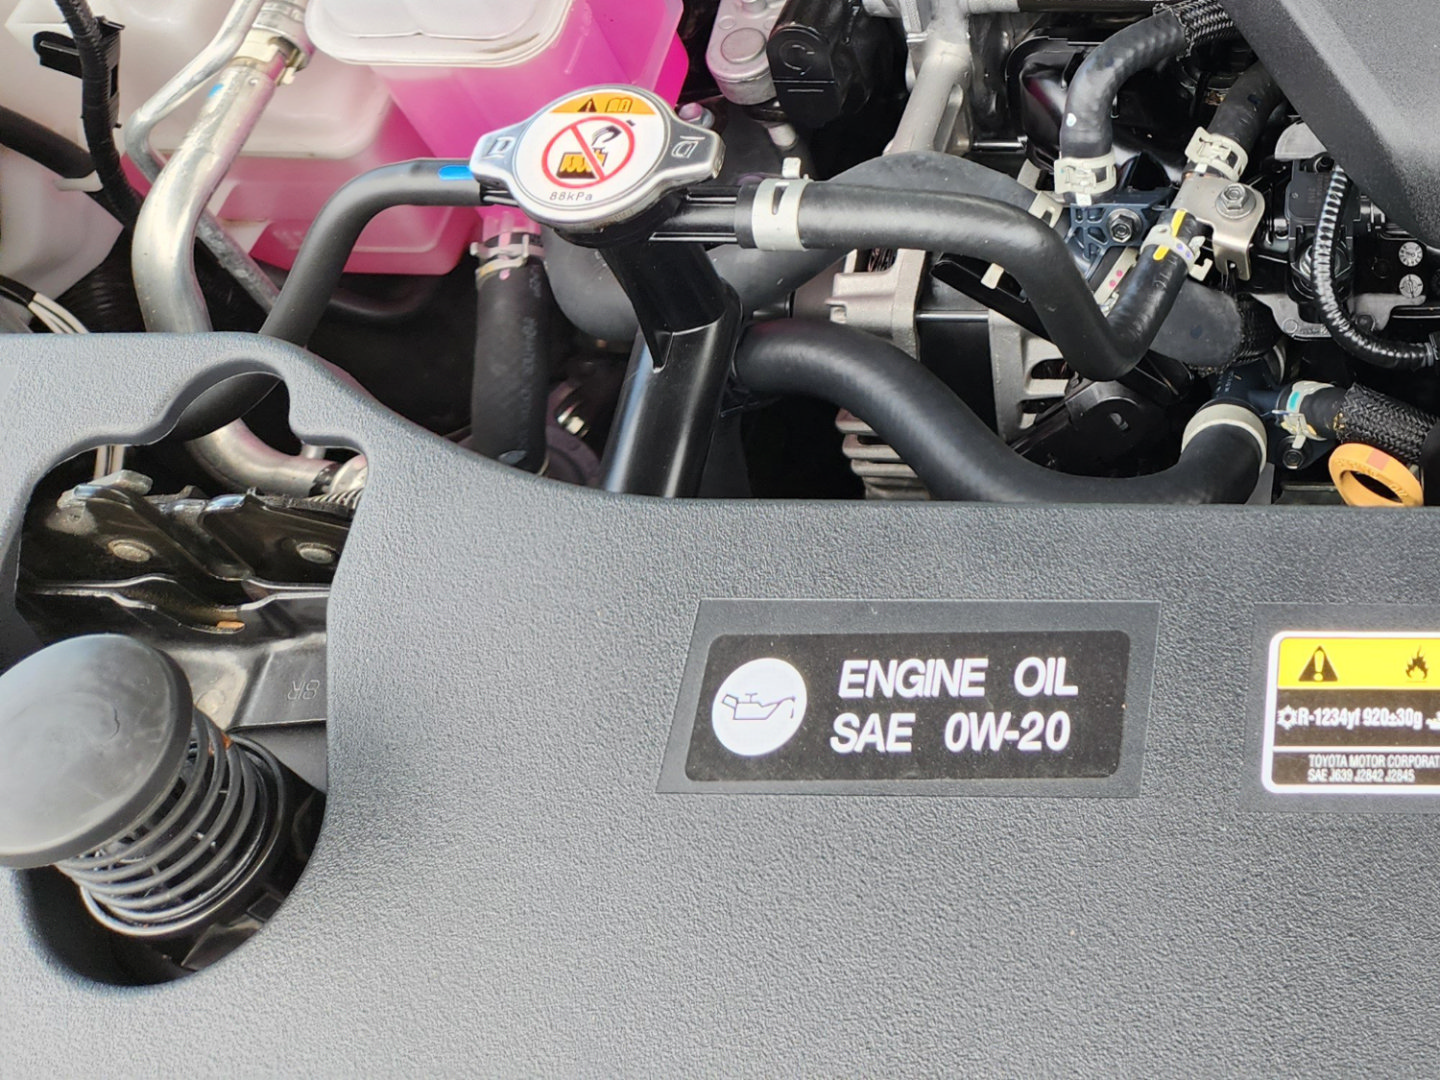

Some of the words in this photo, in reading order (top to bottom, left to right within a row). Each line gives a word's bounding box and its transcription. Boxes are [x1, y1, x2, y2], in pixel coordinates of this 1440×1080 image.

[549, 191, 593, 202] 88kPa
[838, 658, 988, 698] ENGINE
[1014, 656, 1078, 697] OIL
[1297, 706, 1361, 730] R-1234yf
[830, 712, 916, 753] SAE
[944, 710, 1070, 752] 0W-20
[1308, 753, 1348, 768] TOYOTA
[1349, 753, 1386, 768] MOTOR
[1307, 768, 1328, 782] SAE
[1329, 768, 1353, 783] J639
[1354, 768, 1385, 783] J2842
